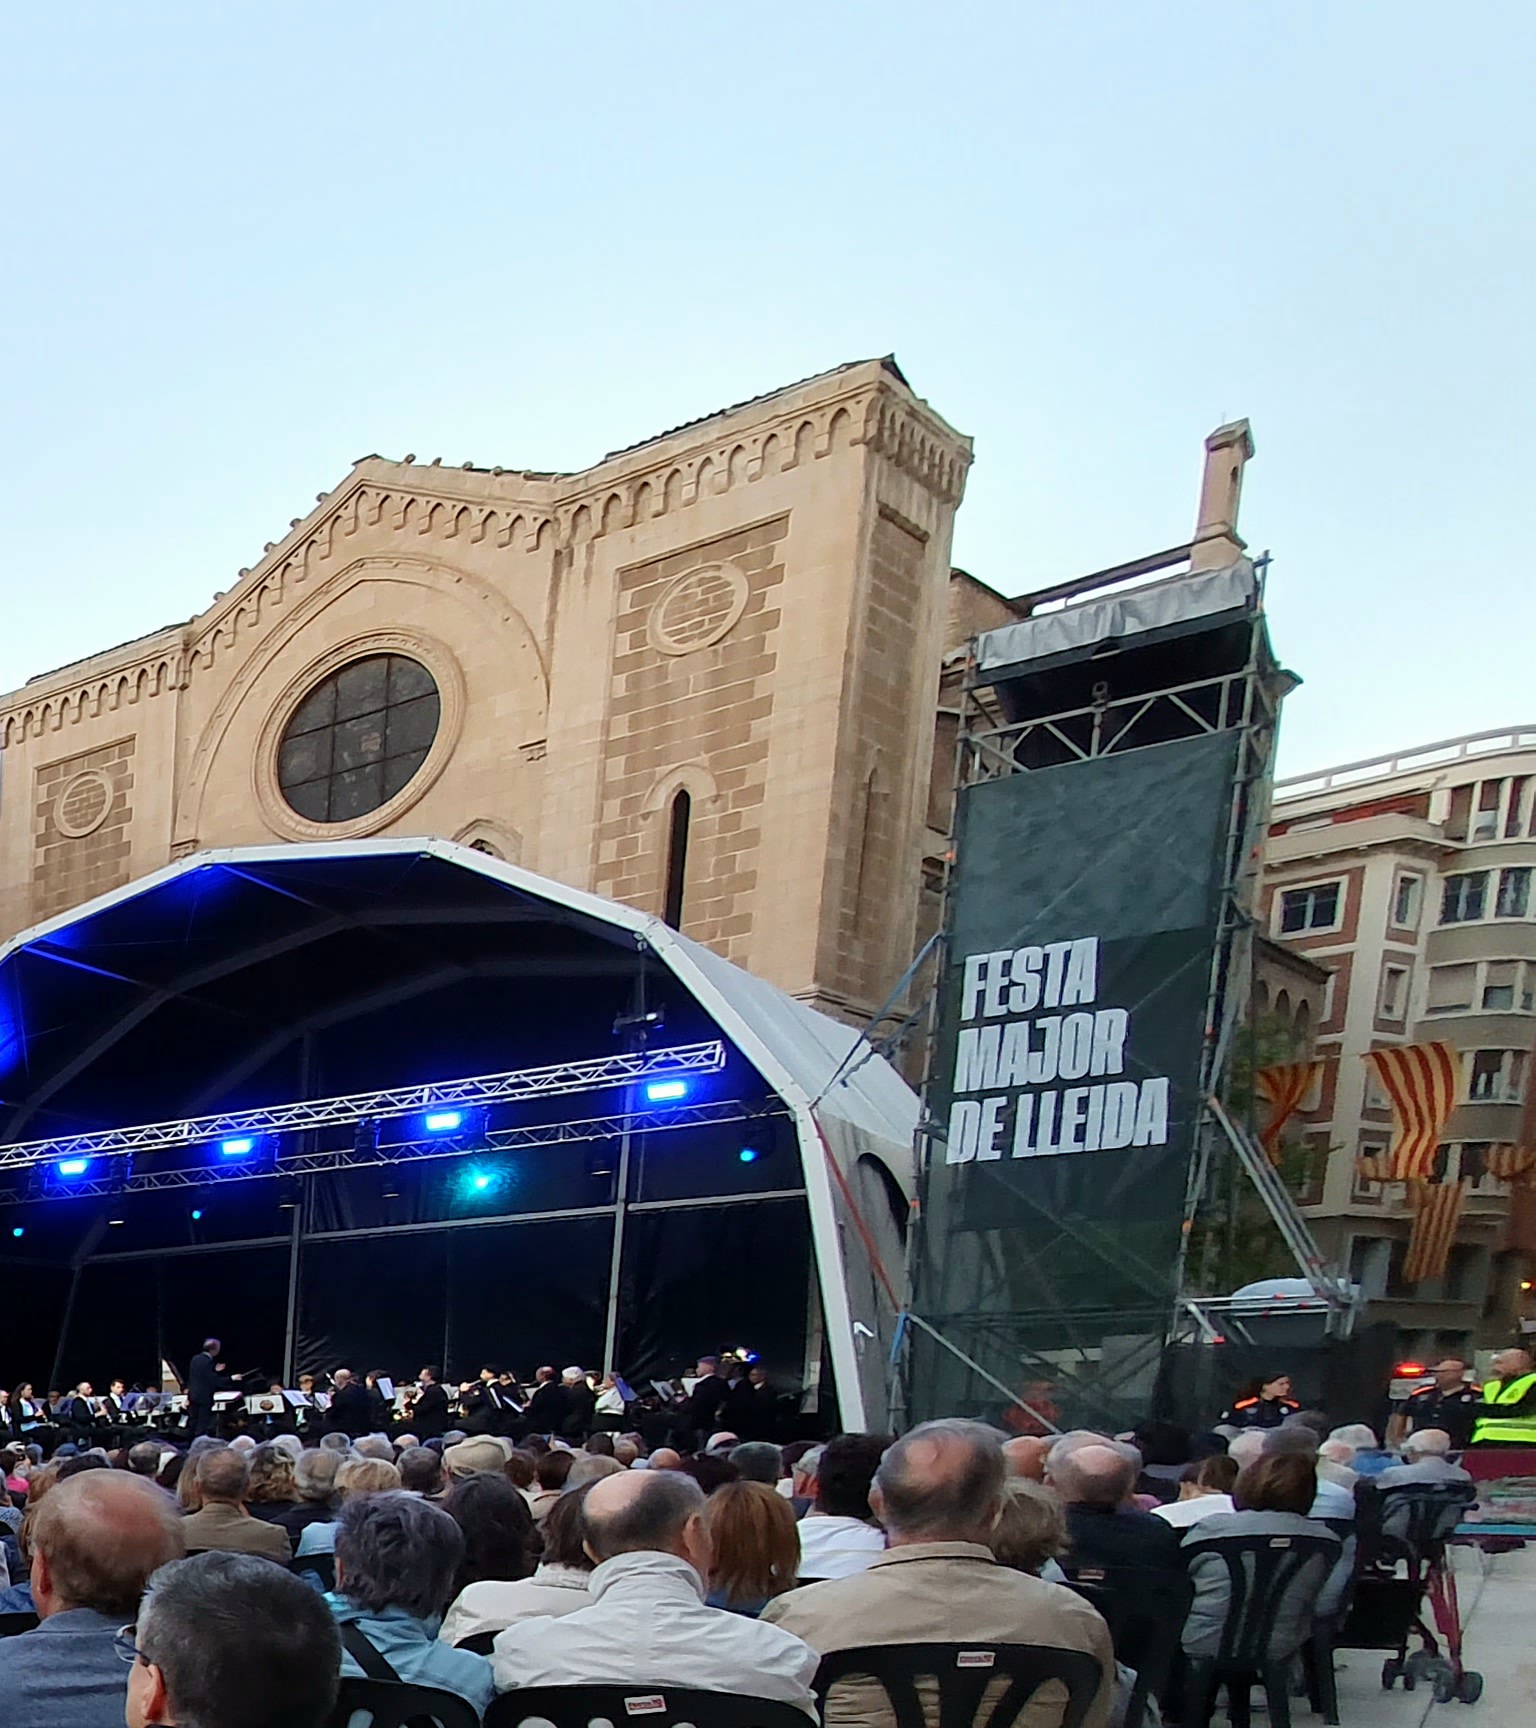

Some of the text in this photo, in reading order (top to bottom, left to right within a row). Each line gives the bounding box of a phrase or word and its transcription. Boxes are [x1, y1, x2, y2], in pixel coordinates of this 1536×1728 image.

[961, 936, 1099, 1021] FESTA
[953, 1008, 1128, 1094] MAJOR
[946, 1077, 1169, 1165] DE LLEIDA
